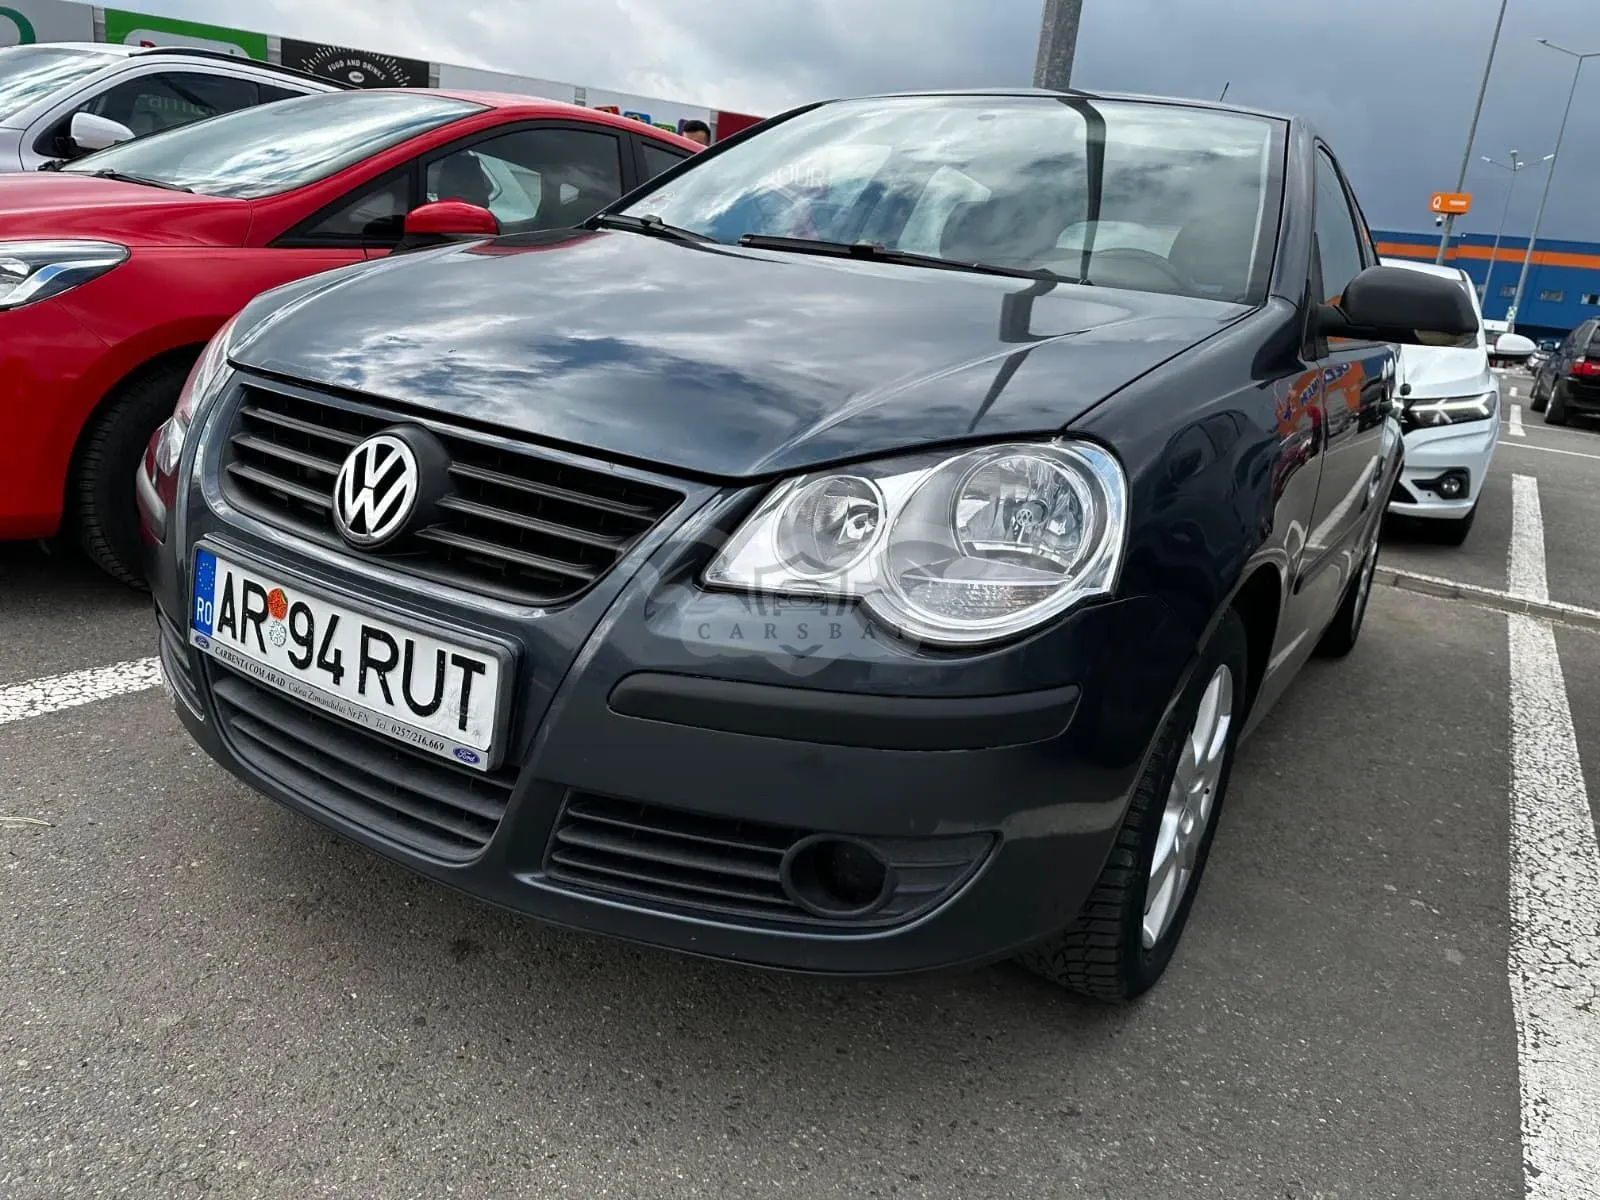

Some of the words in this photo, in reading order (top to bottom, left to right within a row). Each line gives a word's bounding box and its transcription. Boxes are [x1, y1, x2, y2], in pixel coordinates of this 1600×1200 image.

[363, 62, 386, 80] DRINKS
[196, 597, 213, 626] RO
[217, 571, 269, 654] AR
[287, 600, 344, 686] 94
[358, 624, 486, 731] RUT
[266, 671, 286, 687] ARAD
[391, 725, 445, 751] 0257/216.669
